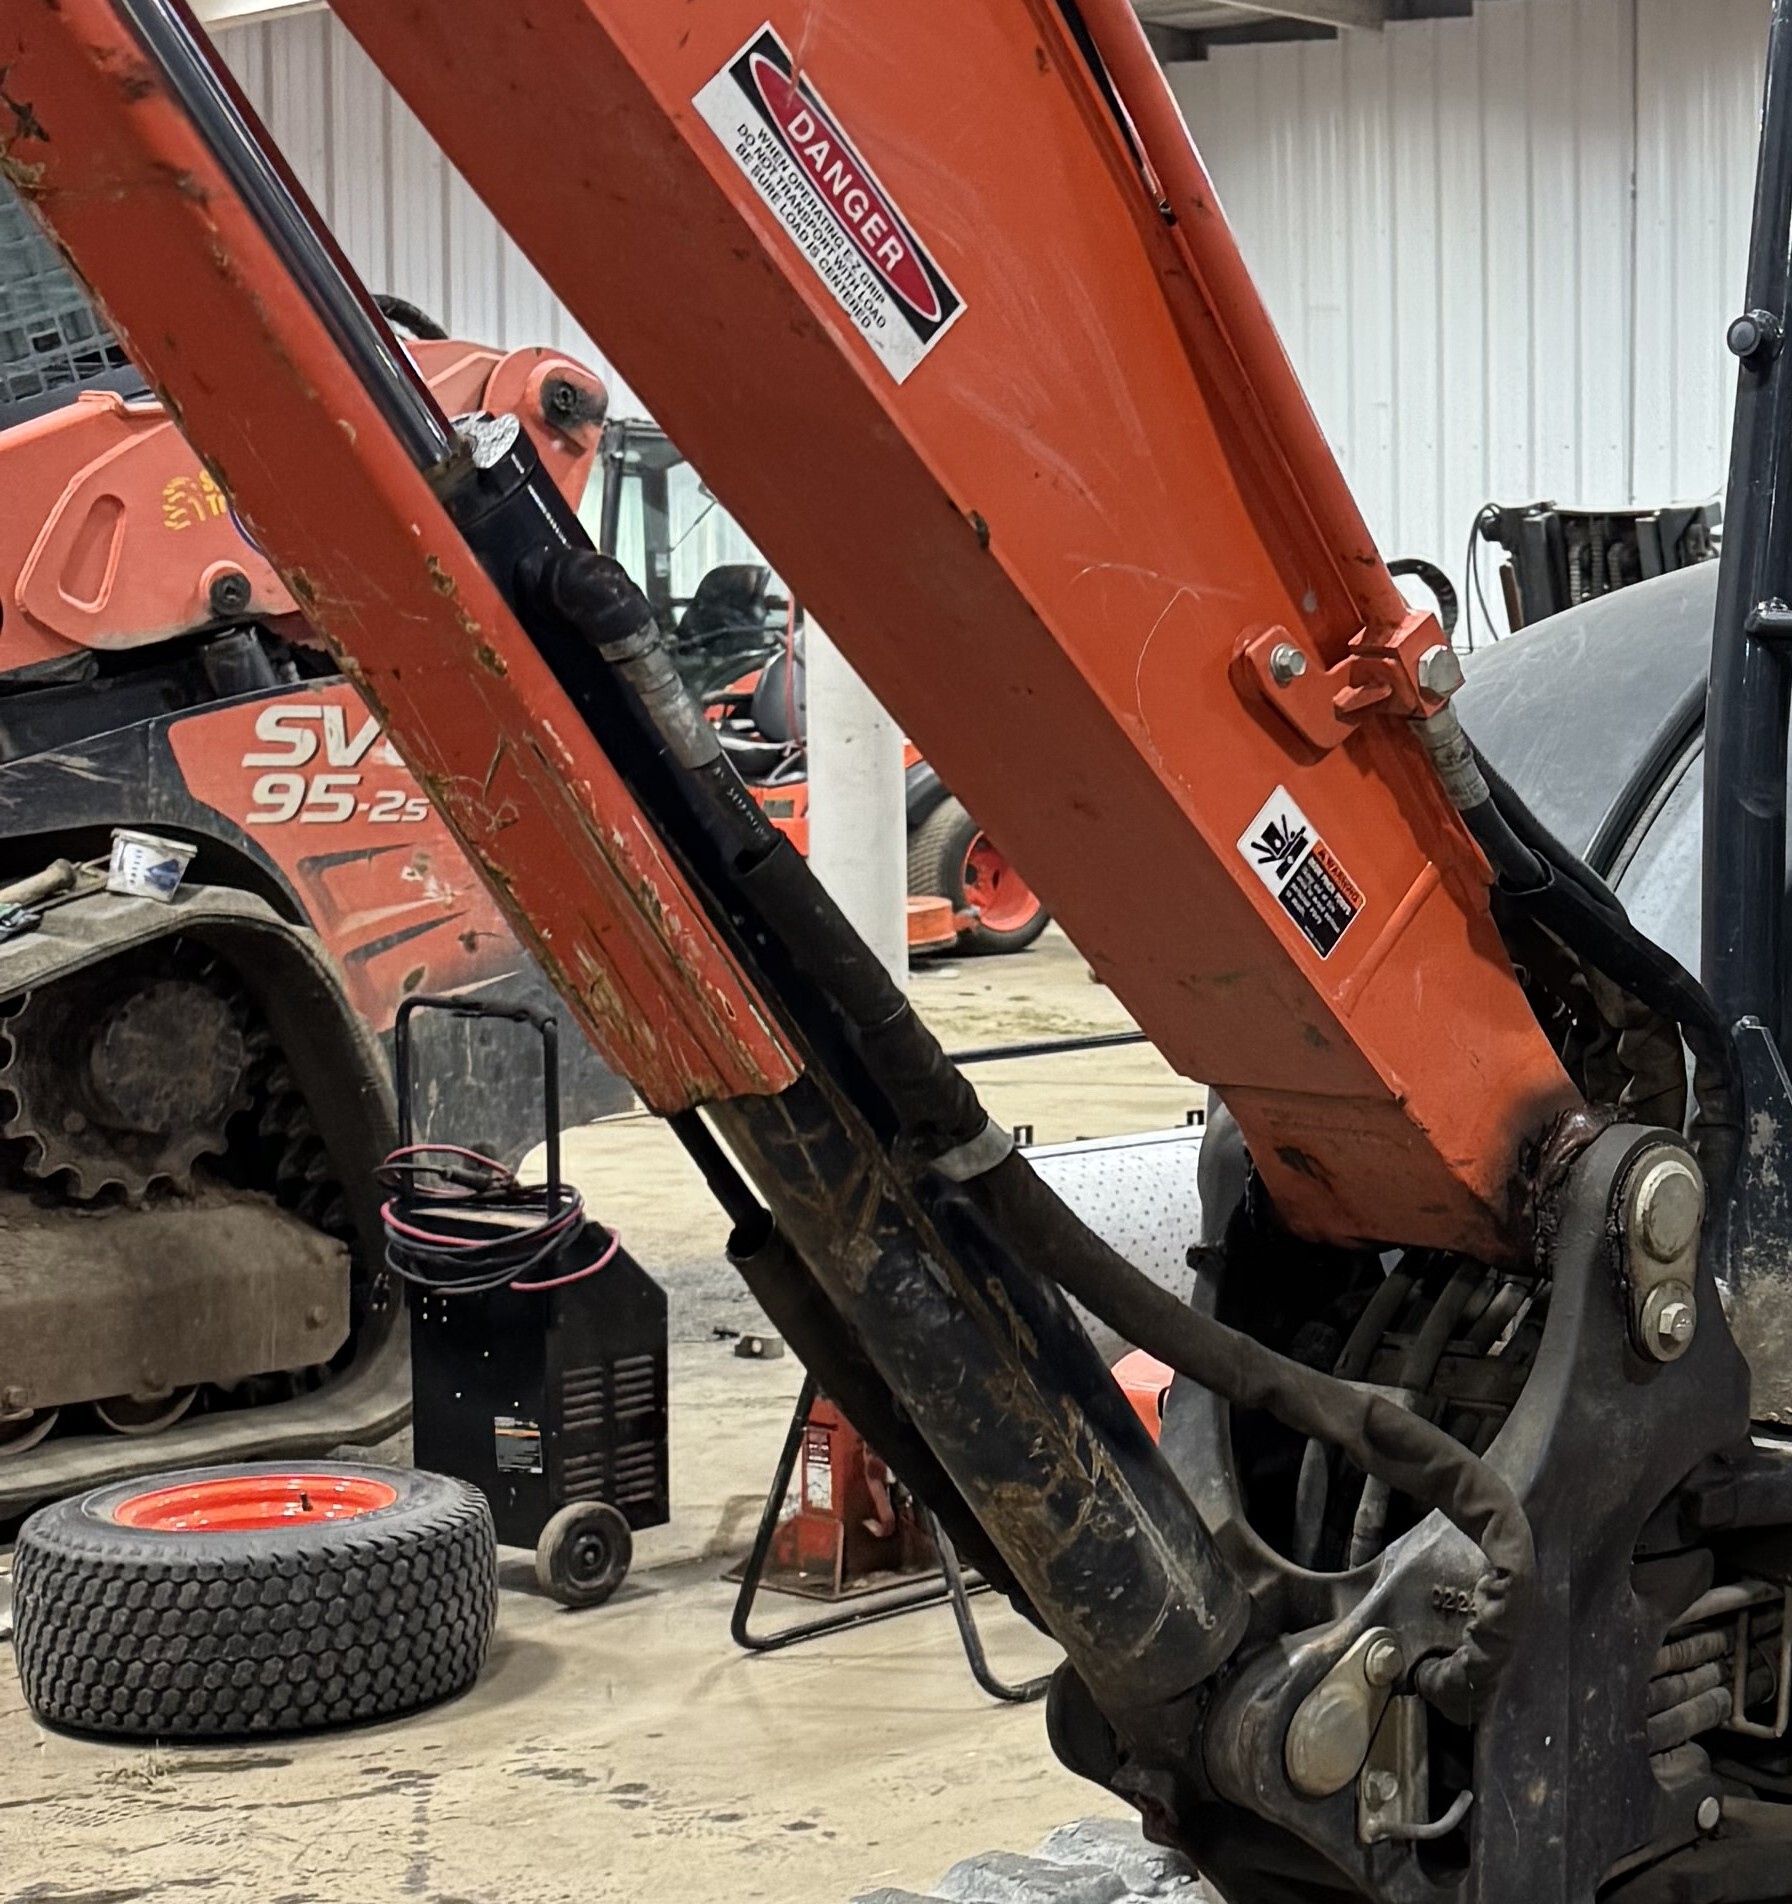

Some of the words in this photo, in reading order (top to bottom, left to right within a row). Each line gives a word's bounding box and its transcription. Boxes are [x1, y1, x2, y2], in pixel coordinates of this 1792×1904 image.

[735, 143, 752, 165] BE
[750, 164, 780, 204] SURE
[778, 204, 808, 243] LOAD
[805, 241, 819, 259] IS
[816, 256, 871, 329] CENTERED
[737, 123, 755, 147] DO
[753, 146, 778, 178] NOT
[774, 176, 836, 258] TRANSPORT
[832, 255, 859, 292] WITH
[856, 289, 887, 329] LOAD
[757, 127, 788, 172] WHEN
[787, 171, 844, 250] OPERATING
[858, 271, 885, 306] GRIP
[786, 109, 906, 272] DANGER
